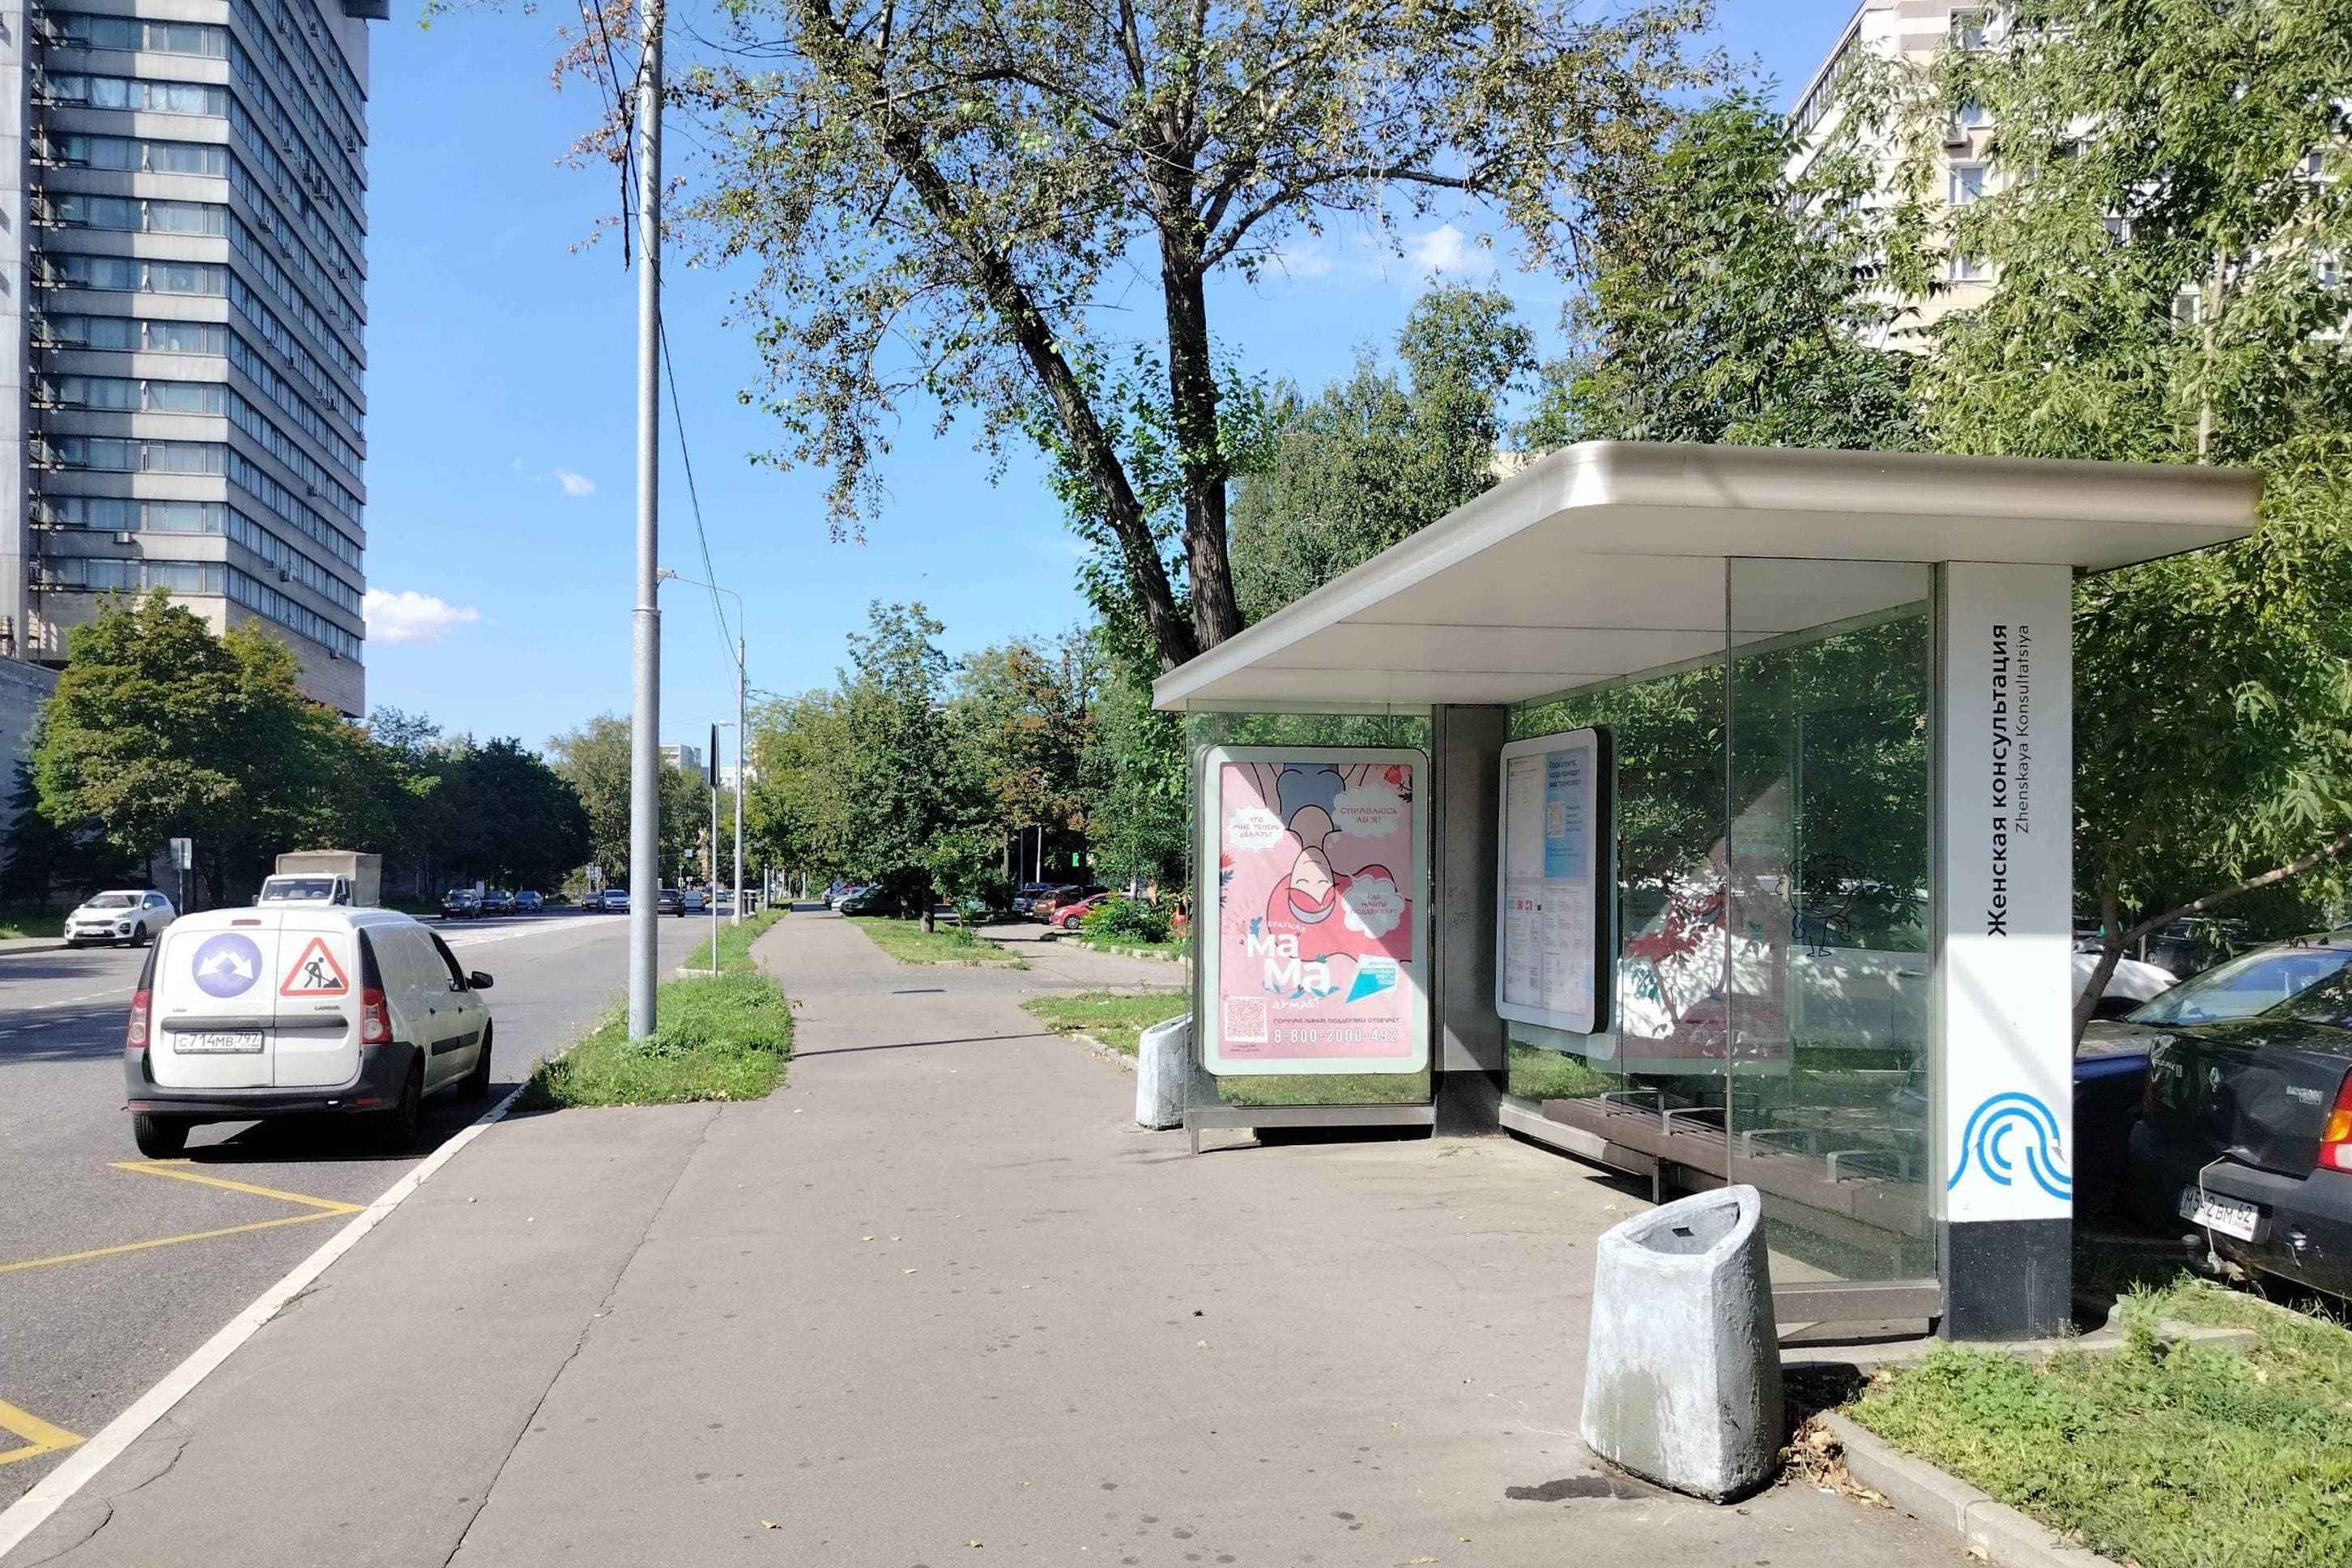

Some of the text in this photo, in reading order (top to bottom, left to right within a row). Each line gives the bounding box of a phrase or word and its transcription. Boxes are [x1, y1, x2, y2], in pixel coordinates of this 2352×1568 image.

[1988, 624, 2012, 937] Женская консультация
[2014, 624, 2032, 833] Zhenskaya Konsultatsiya
[1271, 997, 1320, 1010] ДУМАЕТ
[1274, 1029, 1399, 1043] 8-800-2000-492
